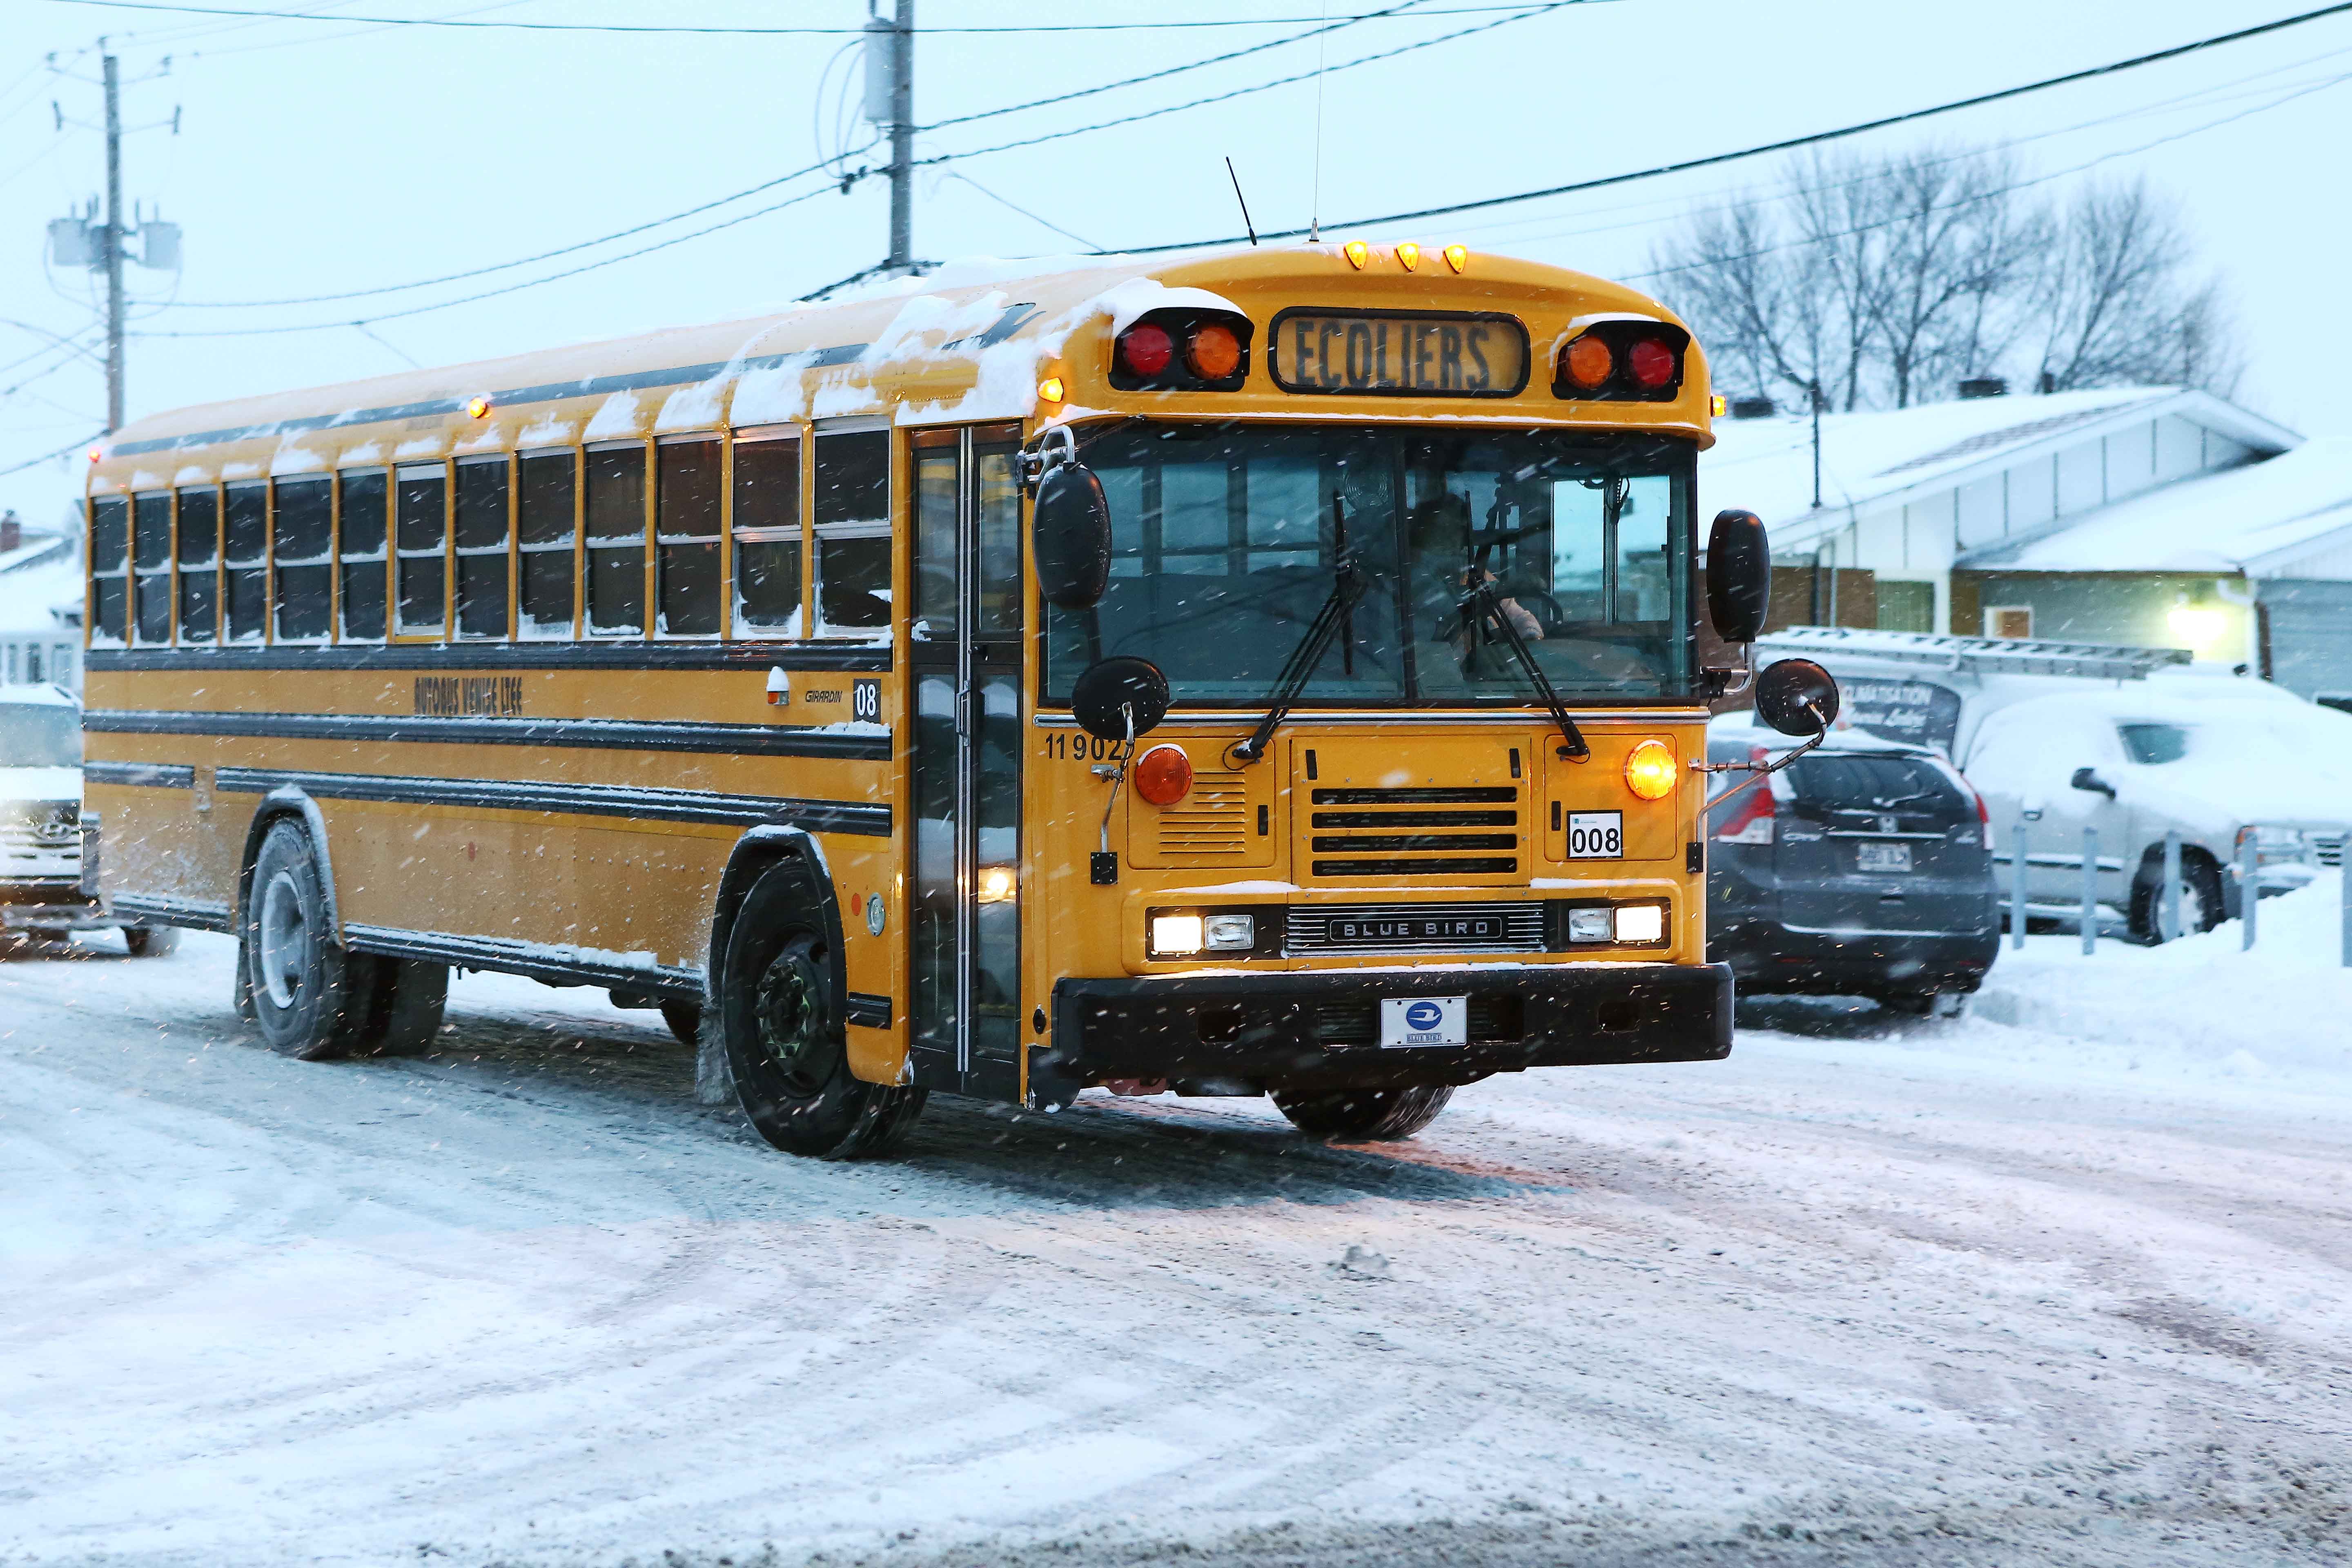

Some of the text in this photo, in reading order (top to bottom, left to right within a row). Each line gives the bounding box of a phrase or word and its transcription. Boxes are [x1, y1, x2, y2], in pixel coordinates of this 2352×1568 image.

[1295, 320, 1490, 390] ECOLIERS
[805, 690, 843, 703] GIRARDIN
[856, 683, 876, 717] 08
[1045, 733, 1122, 761] 11902
[1572, 828, 1619, 853] 008
[1344, 922, 1488, 936] BLUE BIRD
